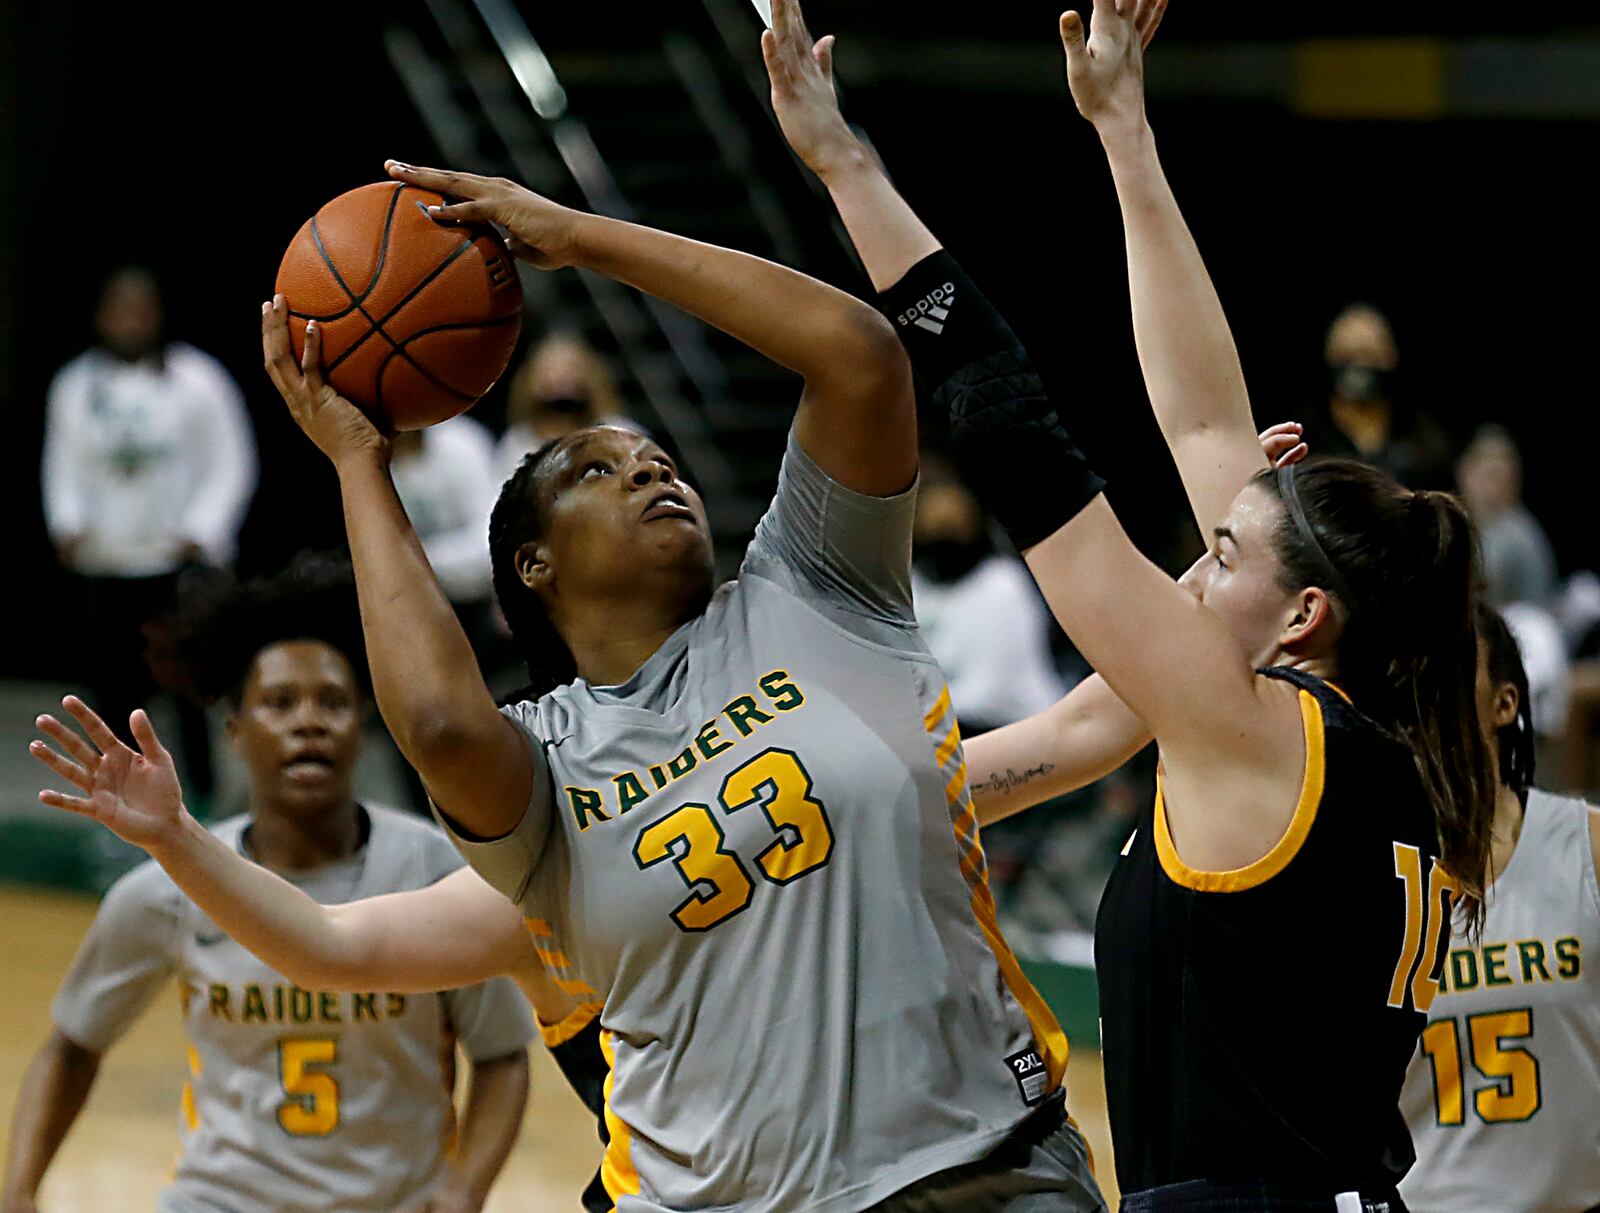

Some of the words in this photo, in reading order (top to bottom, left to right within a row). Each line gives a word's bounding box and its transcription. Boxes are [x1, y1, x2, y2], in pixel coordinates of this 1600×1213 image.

[898, 282, 955, 325] adidas
[565, 670, 804, 832] RAIDERS
[631, 746, 836, 933] 33
[207, 983, 408, 1024] RAIDERS
[276, 1033, 340, 1137] 5
[1013, 1053, 1042, 1073] 2XL
[1421, 1007, 1542, 1127] 15
